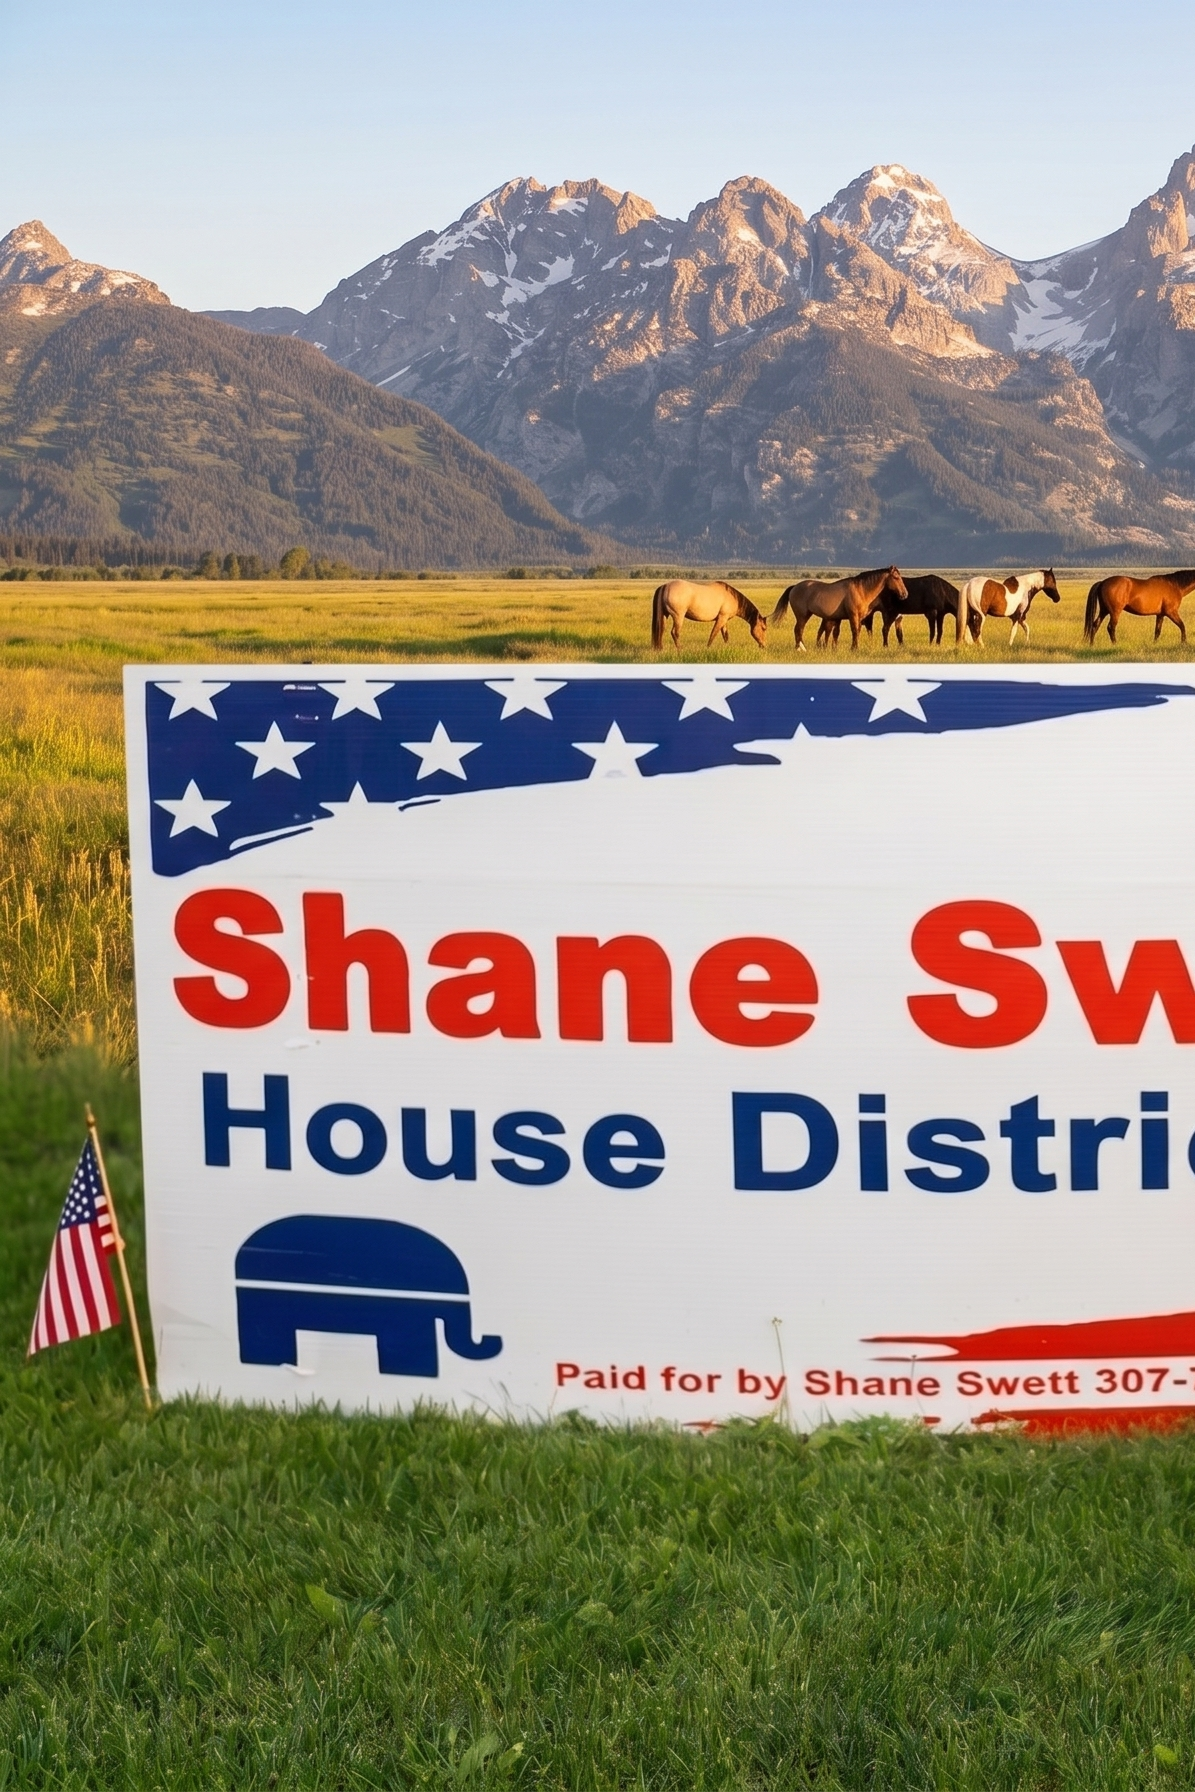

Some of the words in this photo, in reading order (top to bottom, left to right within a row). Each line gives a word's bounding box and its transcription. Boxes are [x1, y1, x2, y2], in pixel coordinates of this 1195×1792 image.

[173, 887, 820, 1048] Shane
[203, 1072, 665, 1189] House
[555, 1363, 647, 1391] Paid
[660, 1366, 722, 1393] for
[737, 1369, 786, 1400] by
[804, 1369, 941, 1396] Shane
[956, 1370, 1080, 1396] Swett
